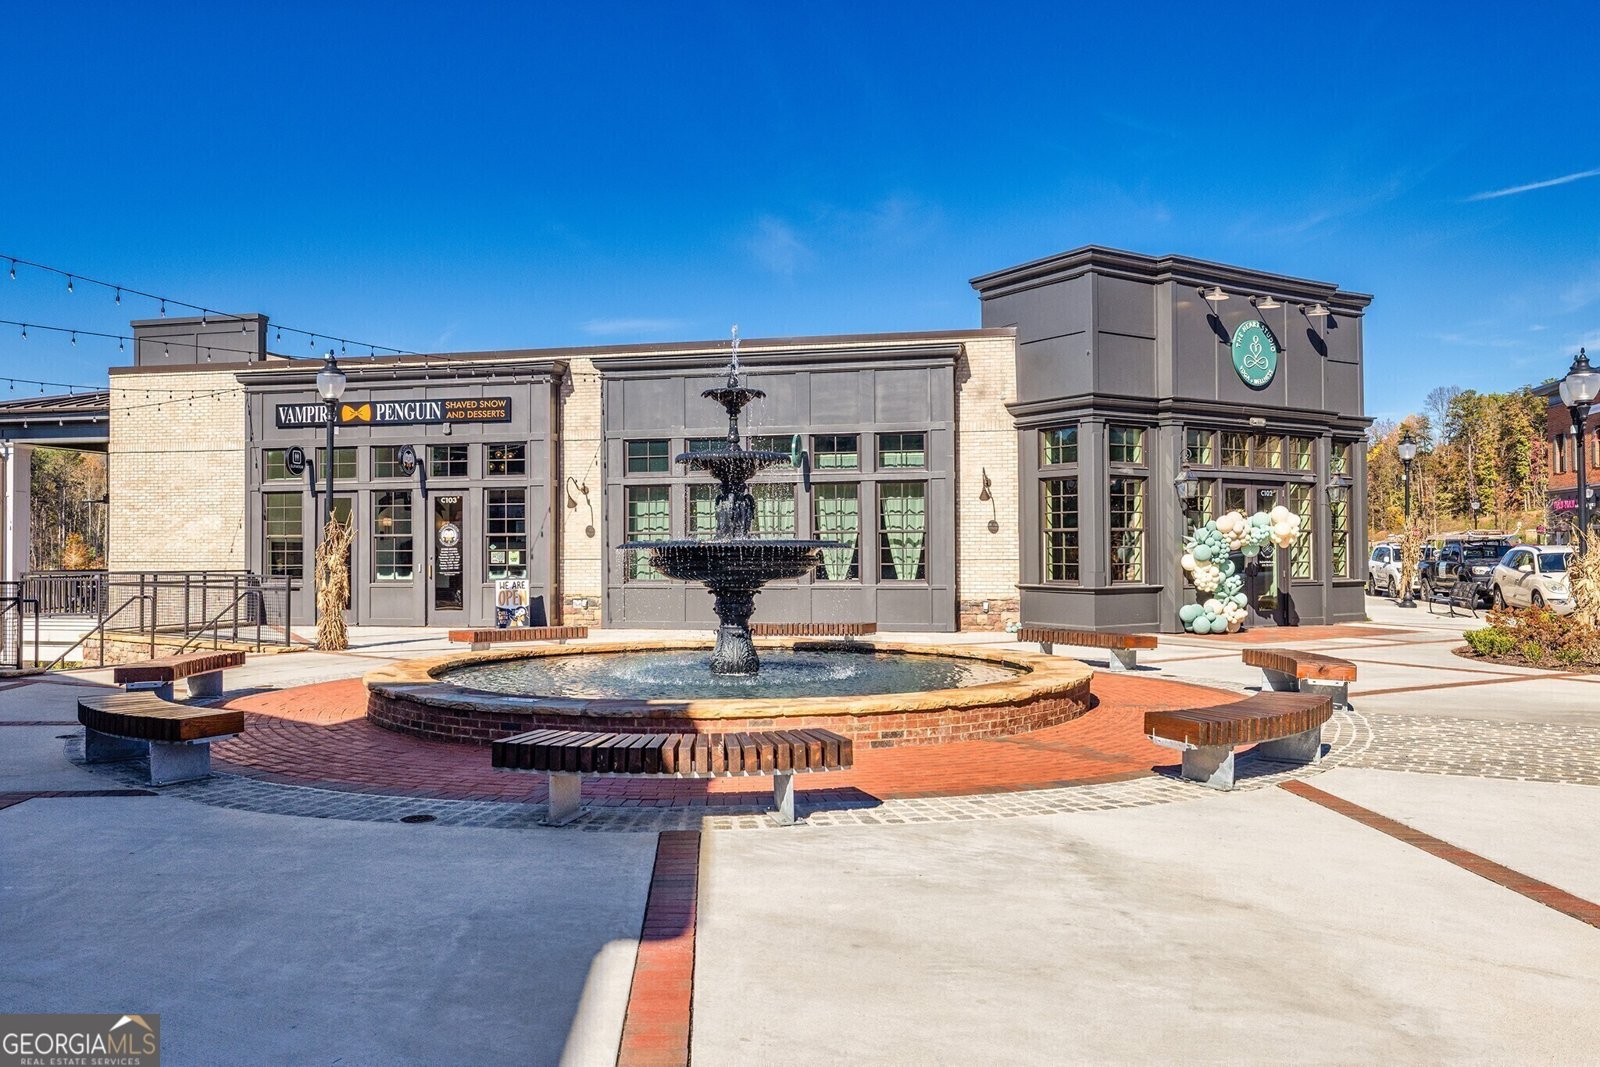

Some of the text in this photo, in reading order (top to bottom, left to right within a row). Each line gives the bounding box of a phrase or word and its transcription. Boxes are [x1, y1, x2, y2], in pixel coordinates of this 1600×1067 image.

[1236, 331, 1245, 349] THE
[1260, 325, 1277, 352] STUDIO
[1240, 365, 1251, 381] YOGA
[445, 400, 507, 409] SHAVED SNOW
[376, 402, 442, 421] PENGUIN
[446, 409, 506, 419] AND DESSERTS
[1260, 489, 1274, 497] C102
[440, 496, 458, 504] C103
[499, 581, 525, 589] WE ARE
[498, 590, 527, 606] OPEN
